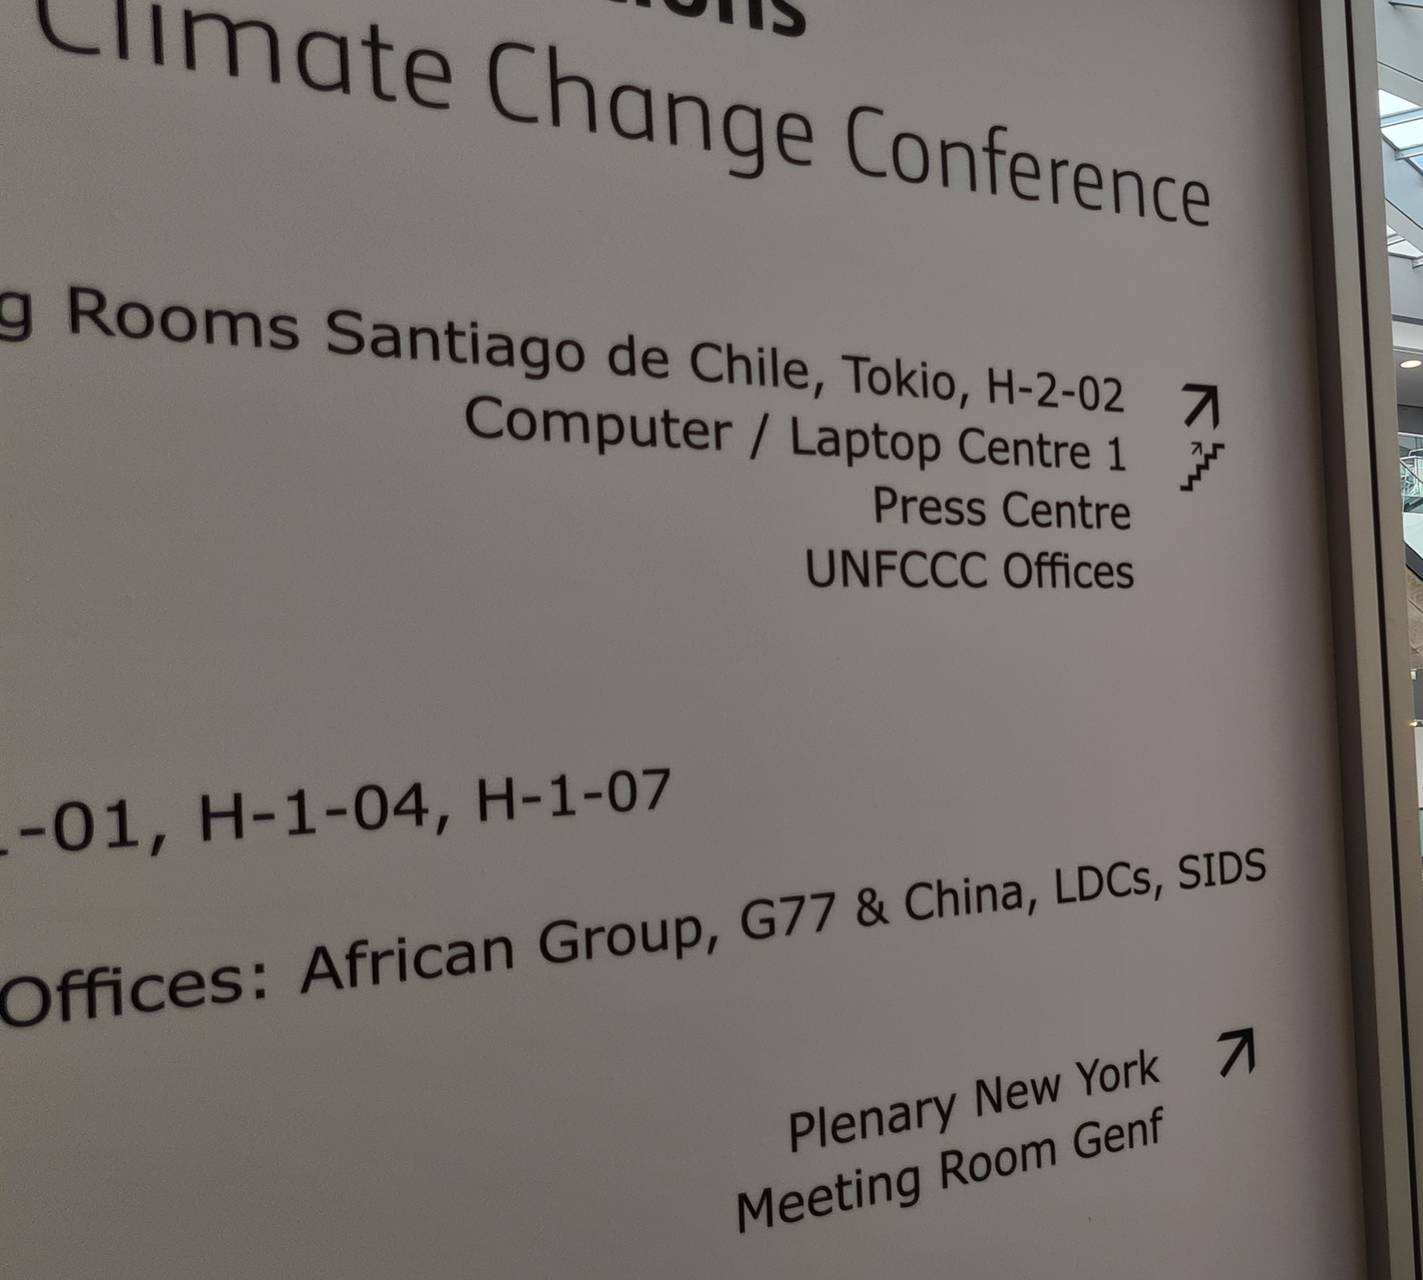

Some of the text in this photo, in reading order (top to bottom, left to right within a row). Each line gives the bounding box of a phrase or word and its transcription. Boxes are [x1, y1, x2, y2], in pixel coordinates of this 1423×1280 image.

[33, 0, 1212, 229] Climate Change Conference
[68, 284, 301, 352] Rooms
[325, 308, 587, 381] Santiago
[607, 333, 670, 380] de
[689, 341, 825, 400] Chile,
[840, 354, 969, 410] Tokio,
[987, 366, 1125, 414] H-2-02
[464, 394, 1127, 472] Computer / Laptop Centre 1
[873, 484, 1132, 531] Press Centre
[805, 547, 1135, 590] UNFCCC Offices
[0, 767, 671, 858] -01, H-1-04, H-1-07
[0, 847, 1267, 1029] Offices: African Group, G77 & China, LDCs, SIDS
[789, 1048, 1161, 1154] Plenary New York
[737, 1105, 1165, 1235] Meeting Room Genf
